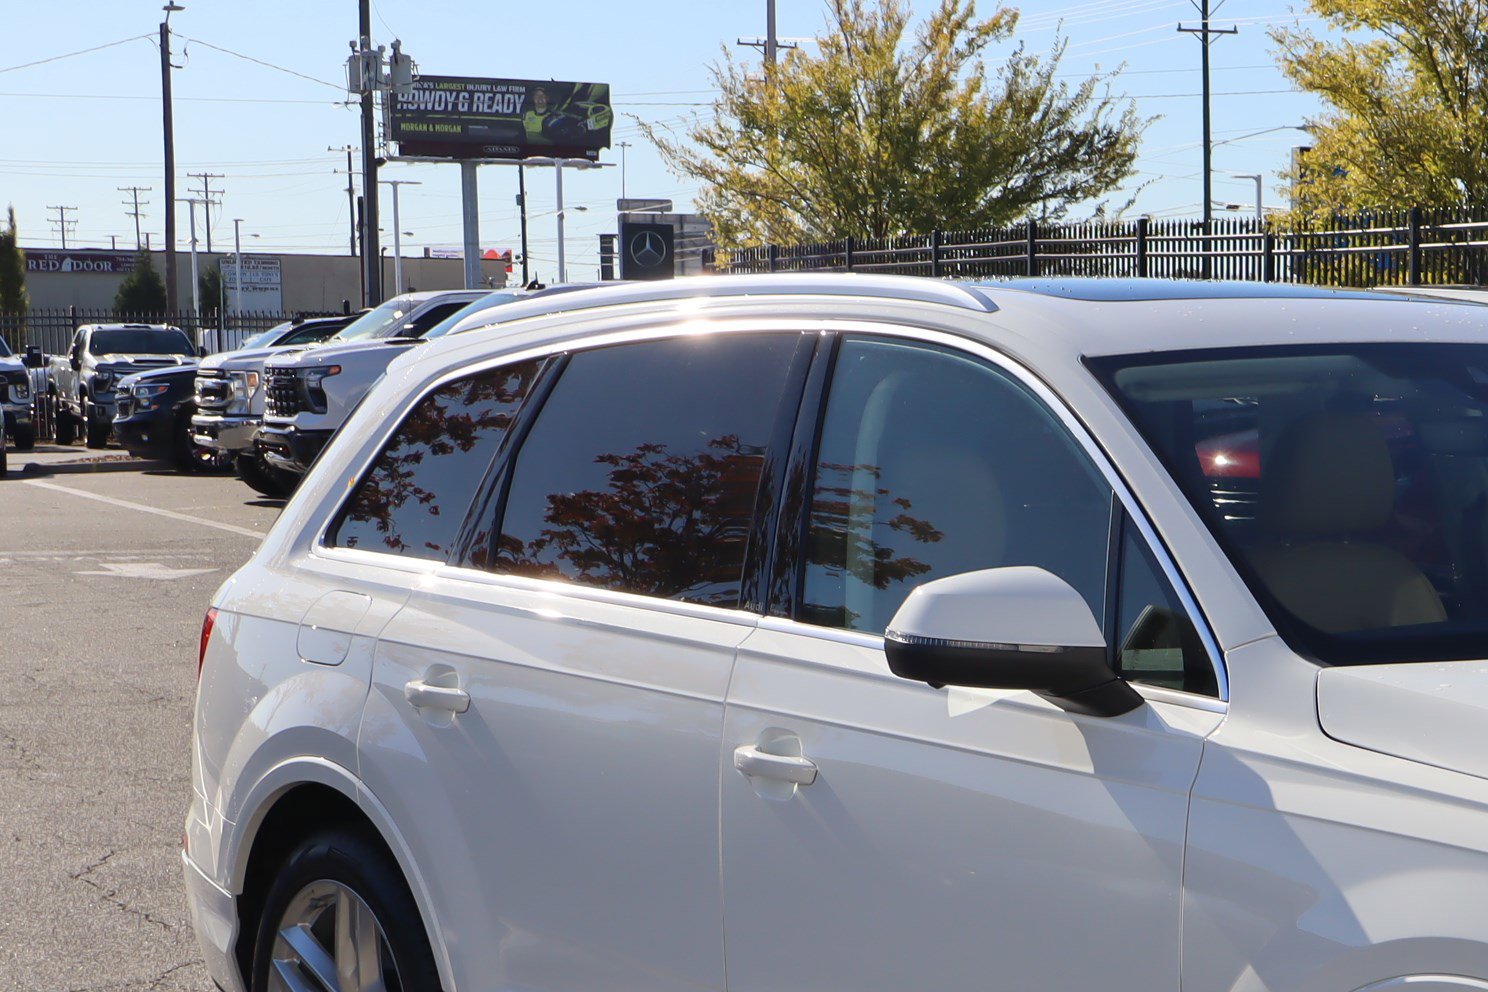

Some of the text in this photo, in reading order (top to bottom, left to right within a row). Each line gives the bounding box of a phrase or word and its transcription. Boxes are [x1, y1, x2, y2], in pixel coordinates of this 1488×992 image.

[435, 82, 465, 91] LARGEST
[466, 84, 492, 92] INJURY
[397, 90, 456, 111] ROWDY
[472, 91, 525, 114] READY
[400, 122, 428, 132] MORGAN
[428, 124, 434, 132] &
[435, 123, 462, 133] MORGAN
[28, 259, 60, 271] RED
[73, 260, 112, 271] DOOR
